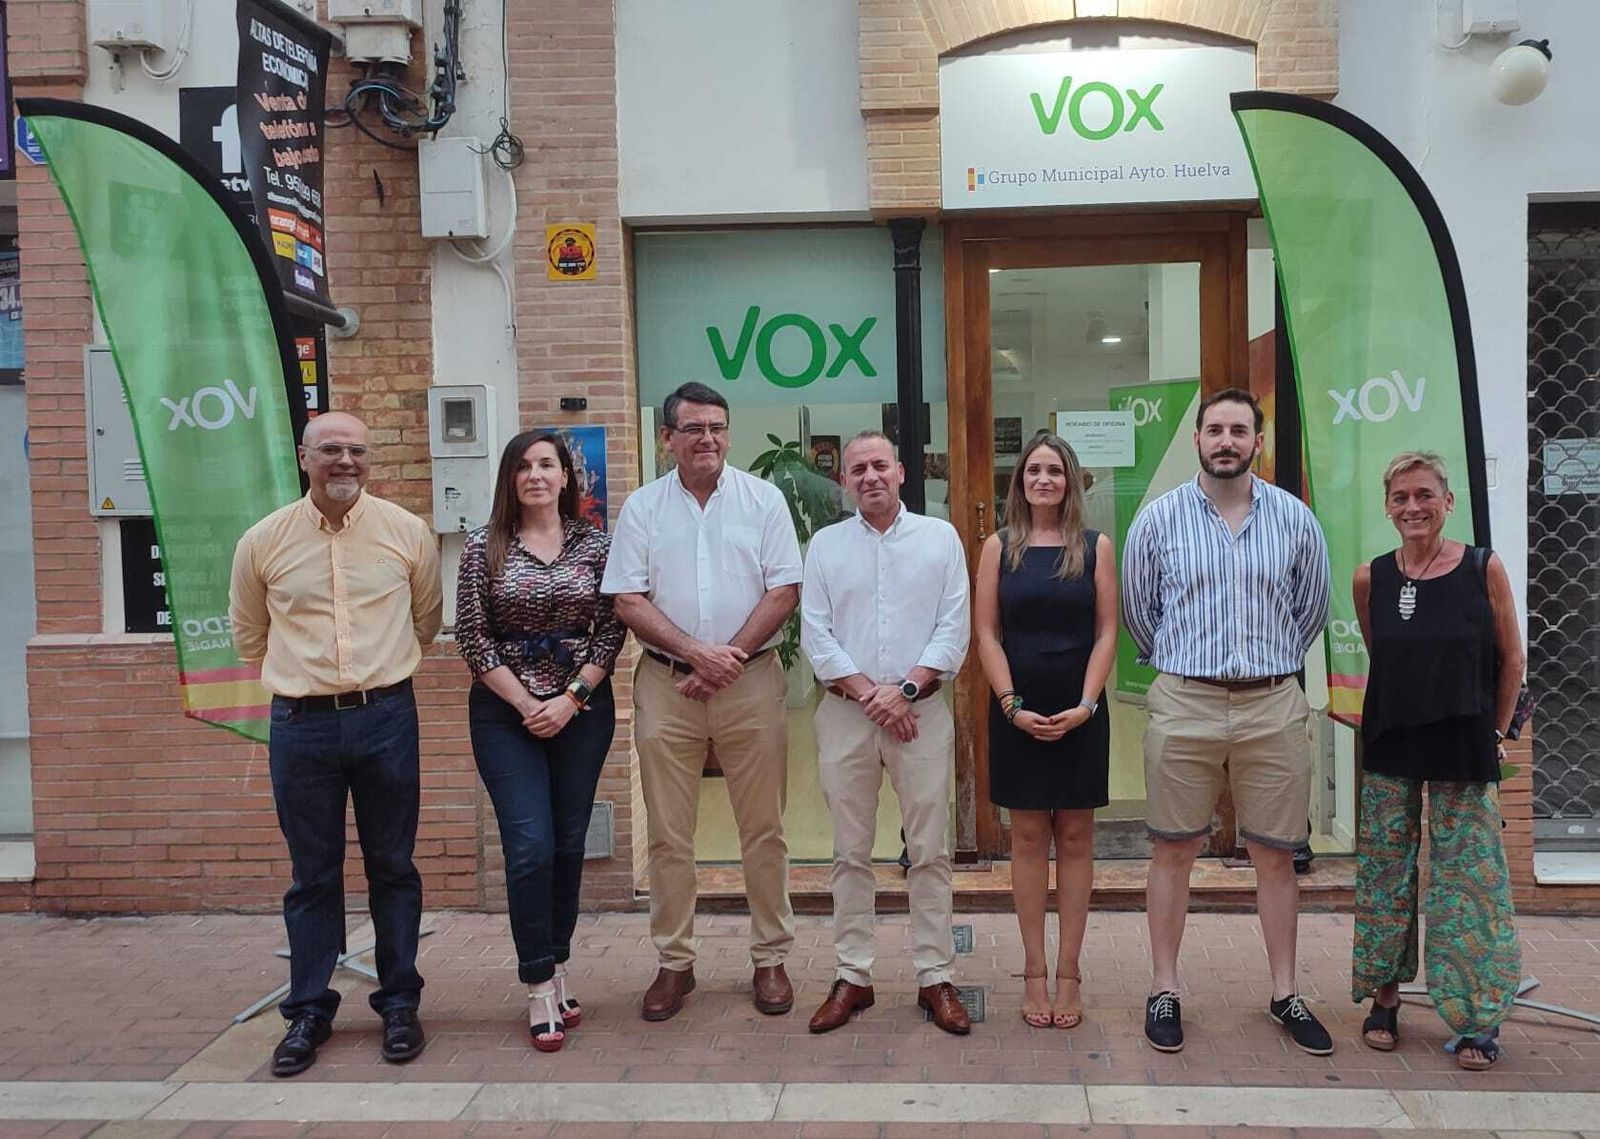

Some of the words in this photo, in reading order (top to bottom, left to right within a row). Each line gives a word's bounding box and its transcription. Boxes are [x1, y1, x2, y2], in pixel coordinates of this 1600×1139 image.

[250, 18, 272, 47] ALTAS
[272, 30, 285, 53] DE
[1030, 76, 1165, 140] VOX
[263, 166, 284, 188] Tel.
[988, 170, 1037, 186] Grupo
[1042, 165, 1123, 184] Municipal
[1129, 166, 1168, 183] Ayto.
[1174, 162, 1231, 178] Huelva
[706, 306, 878, 388] VOX
